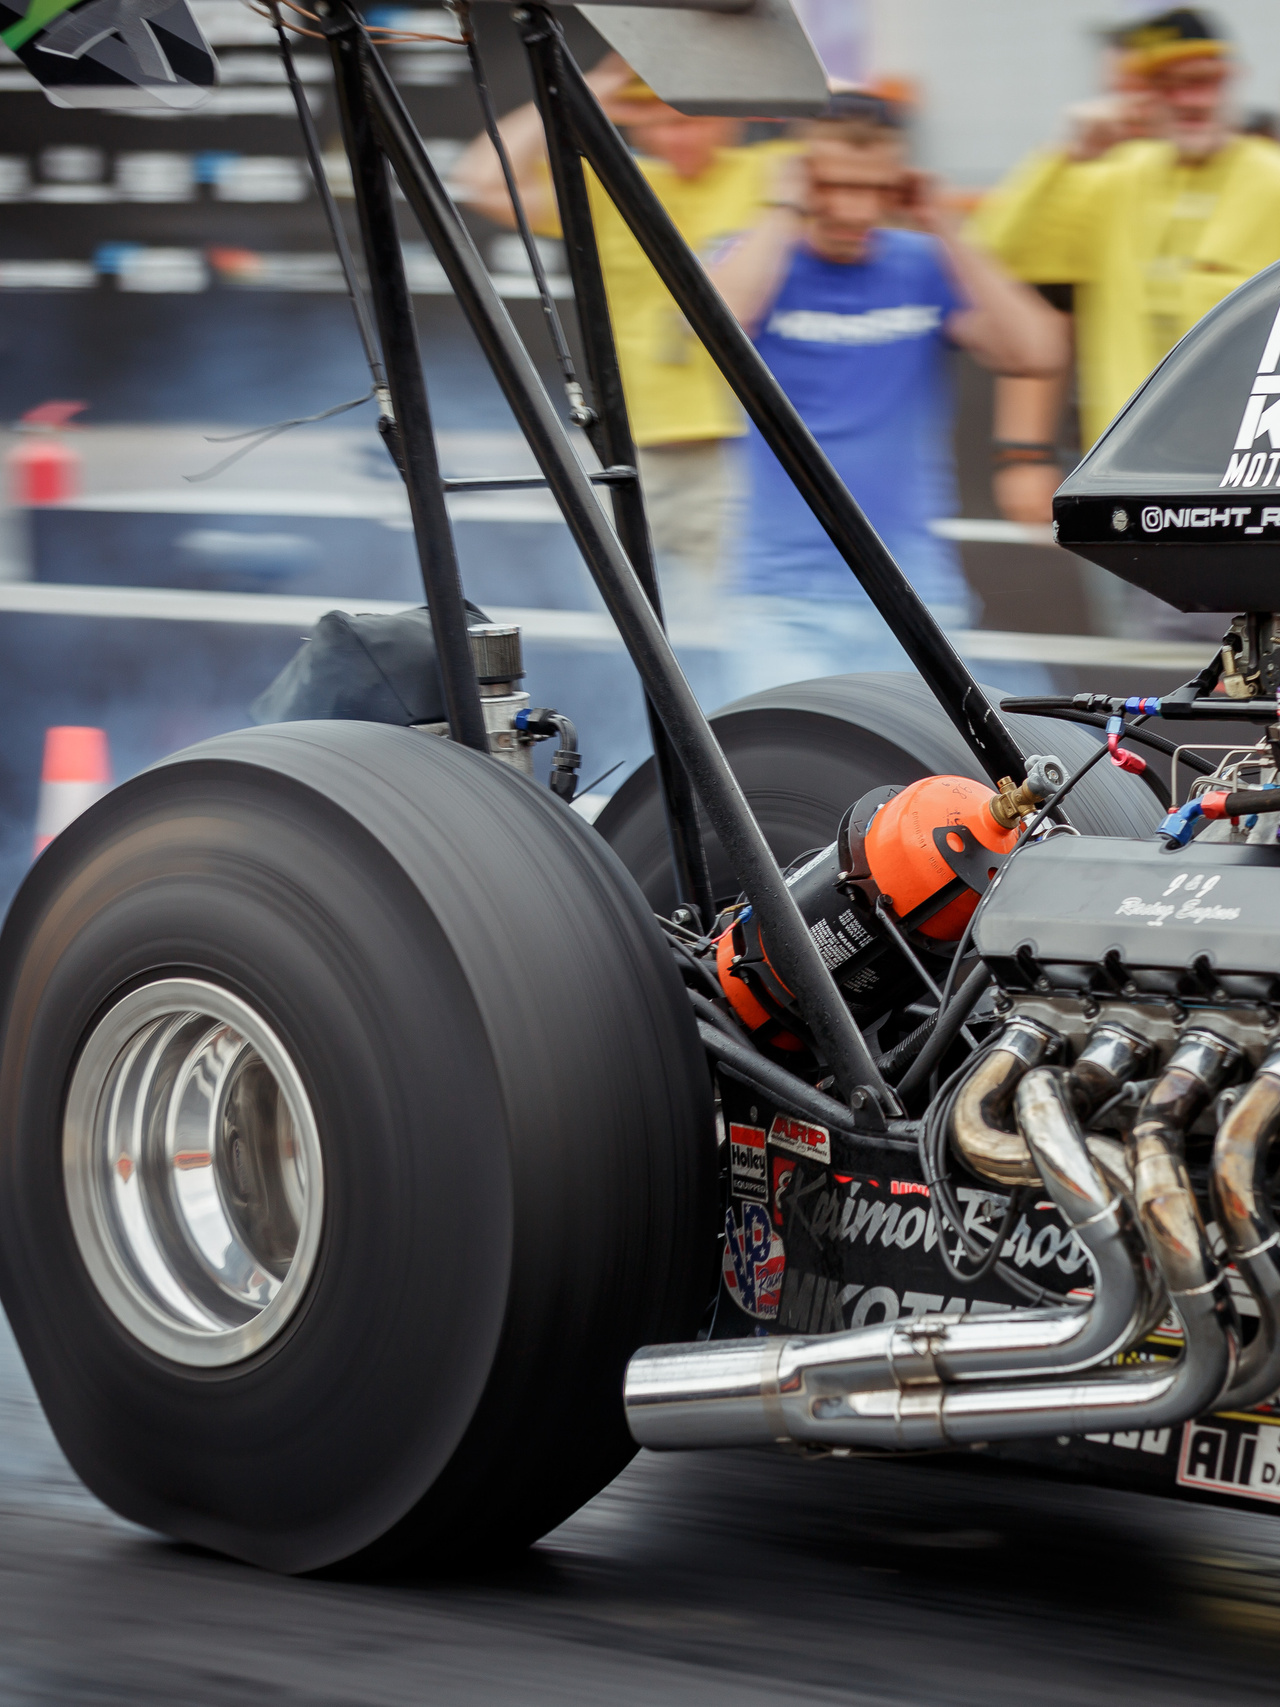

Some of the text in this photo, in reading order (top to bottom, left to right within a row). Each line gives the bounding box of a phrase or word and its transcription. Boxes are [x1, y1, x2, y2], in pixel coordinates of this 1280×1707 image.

[844, 924, 859, 942] WATT
[849, 921, 863, 938] WATT
[852, 918, 867, 936] WATT
[836, 930, 858, 956] WARN
[772, 1117, 827, 1147] ARP
[732, 1144, 767, 1178] Holley
[1187, 1426, 1258, 1487] ATI
